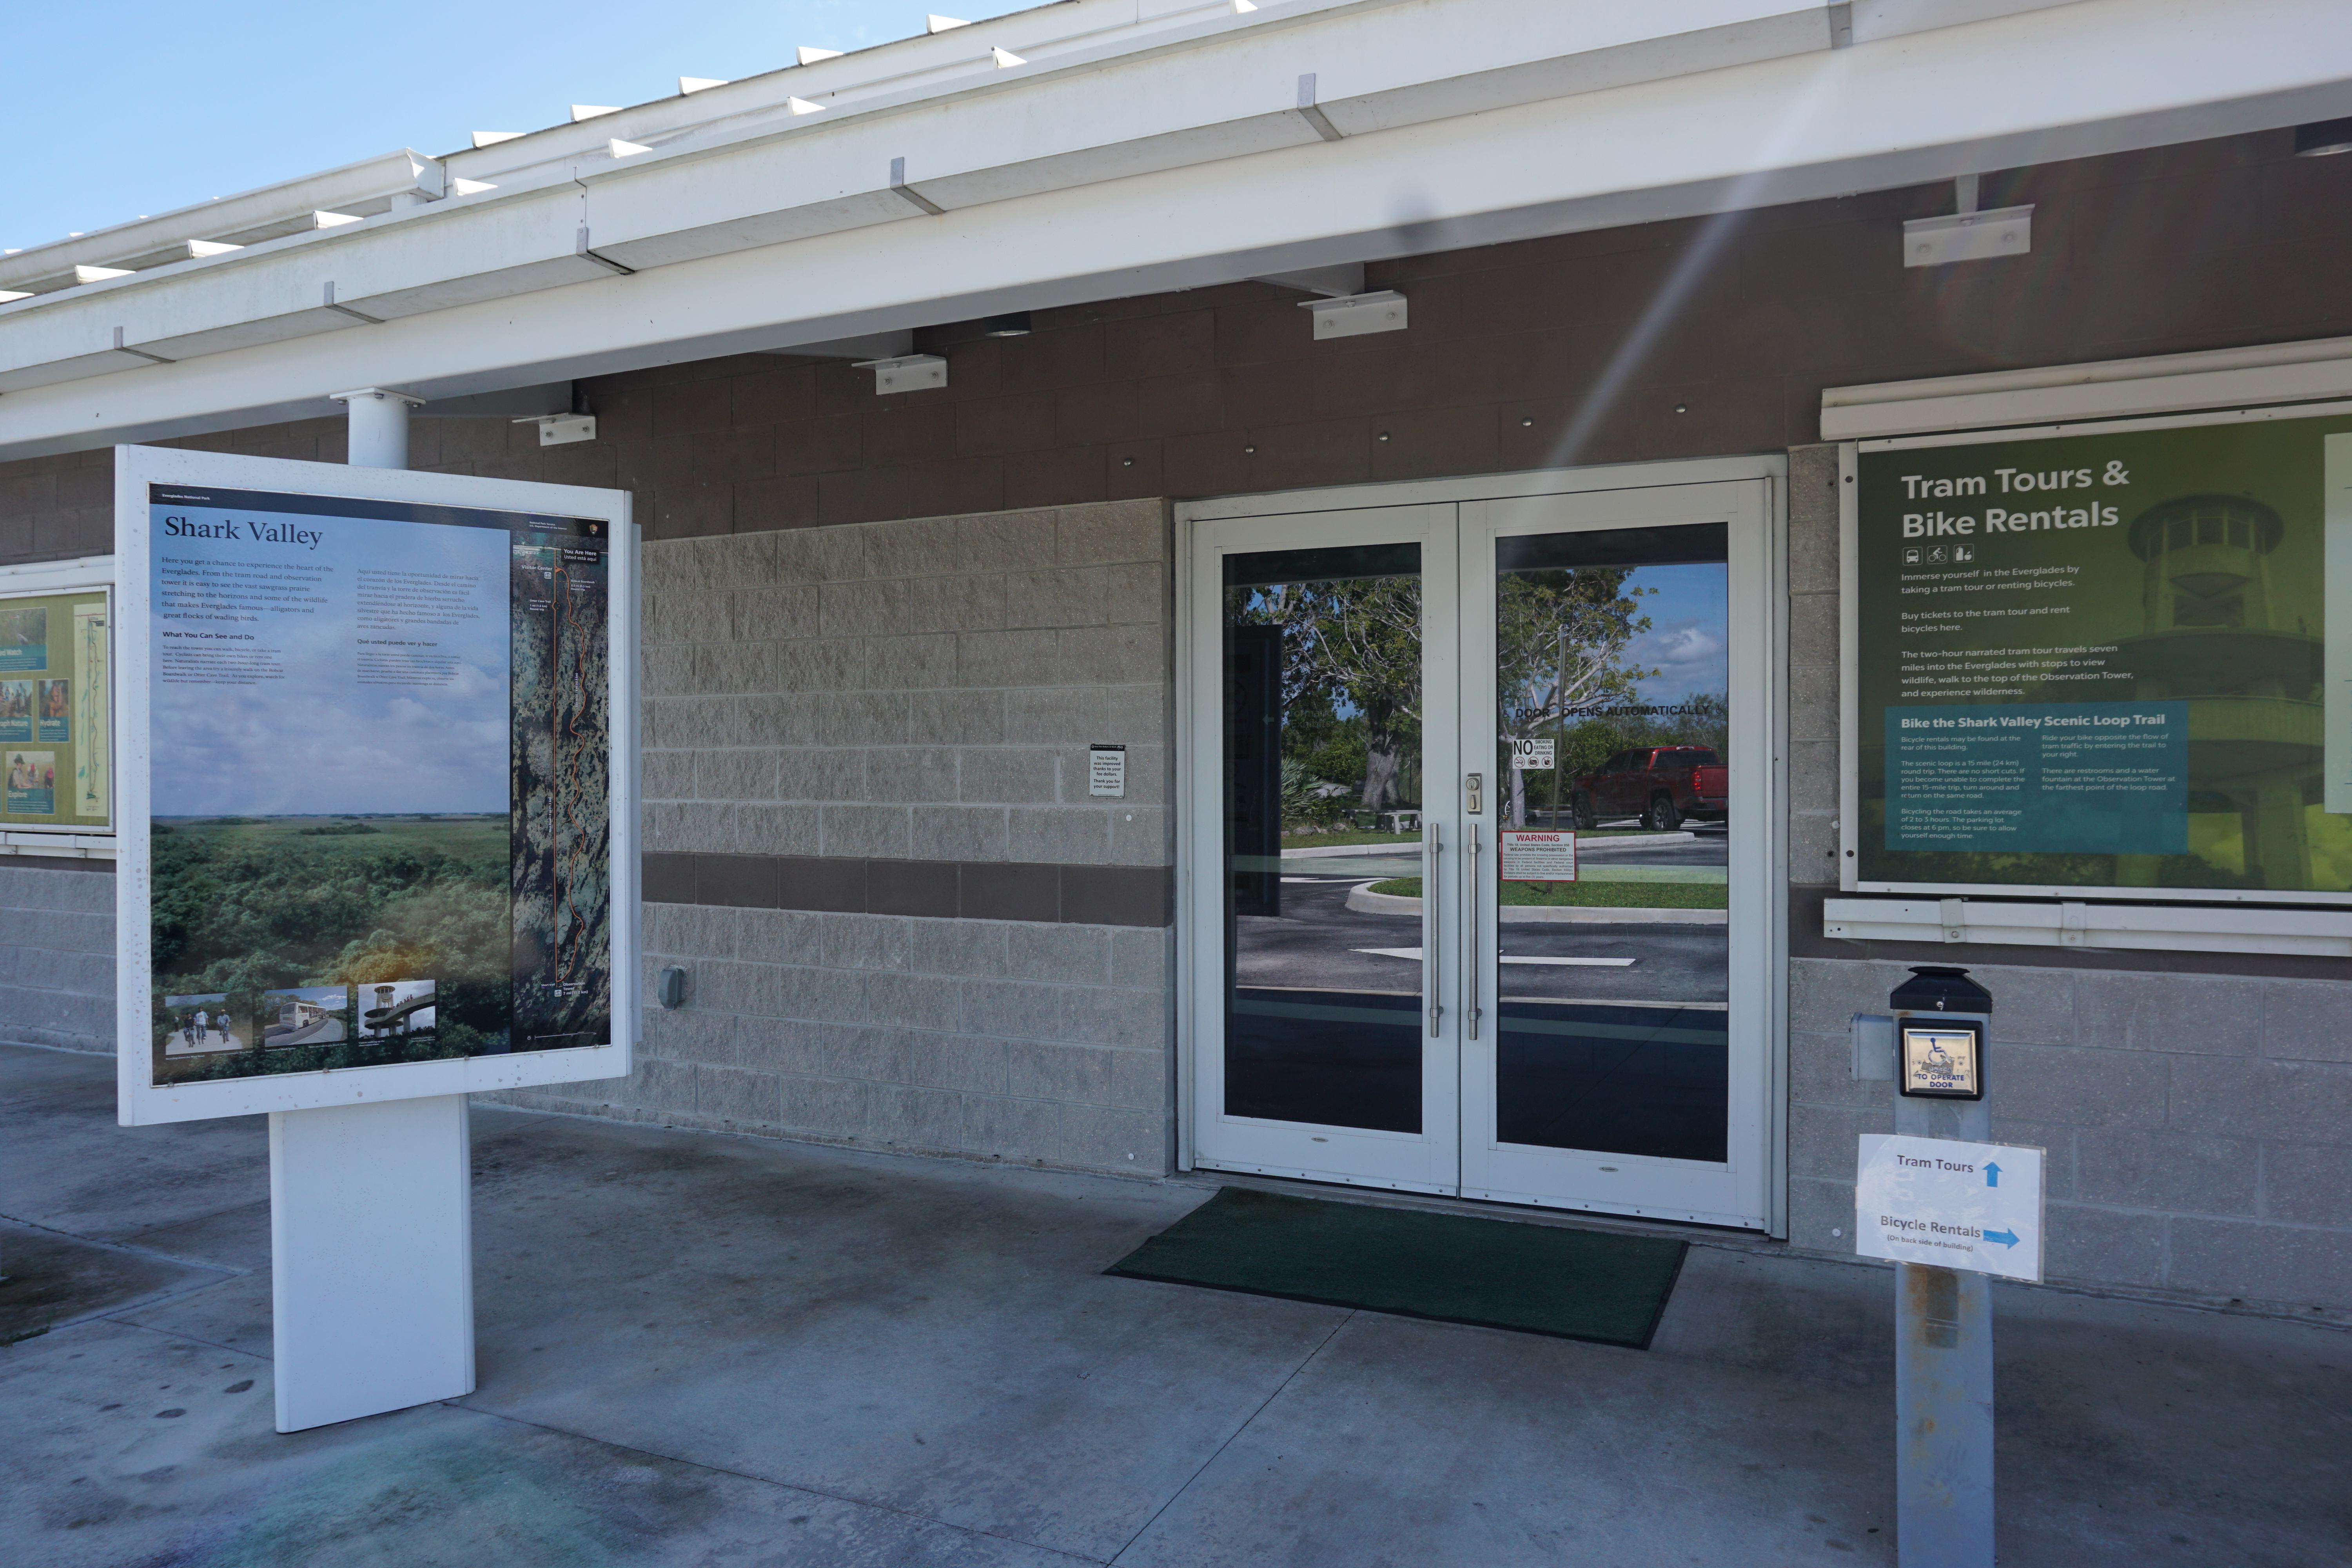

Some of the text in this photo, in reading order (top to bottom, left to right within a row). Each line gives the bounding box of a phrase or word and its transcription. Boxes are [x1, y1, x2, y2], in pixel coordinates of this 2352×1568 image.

[1901, 461, 2129, 498] Tram Tours &
[1904, 502, 2118, 537] Bike Rentals
[165, 517, 323, 550] Shark Valley
[1942, 570, 1980, 580] yourself
[2013, 566, 2065, 576] Everglades
[2067, 565, 2079, 574] by
[2034, 579, 2075, 588] bicycles.
[1902, 625, 1938, 633] bicycles
[1516, 705, 1709, 718] DOOR OPENS AUTOMATICALLY
[1902, 714, 2165, 728] Bike the Shark Valley Scenic Loop Trail
[1514, 740, 1533, 755] NO
[8, 791, 27, 799] Explore
[1897, 1155, 1973, 1172] Tram Tours
[1881, 1216, 1980, 1237] Bicycle Rentals
[1943, 1242, 1973, 1252] building)
